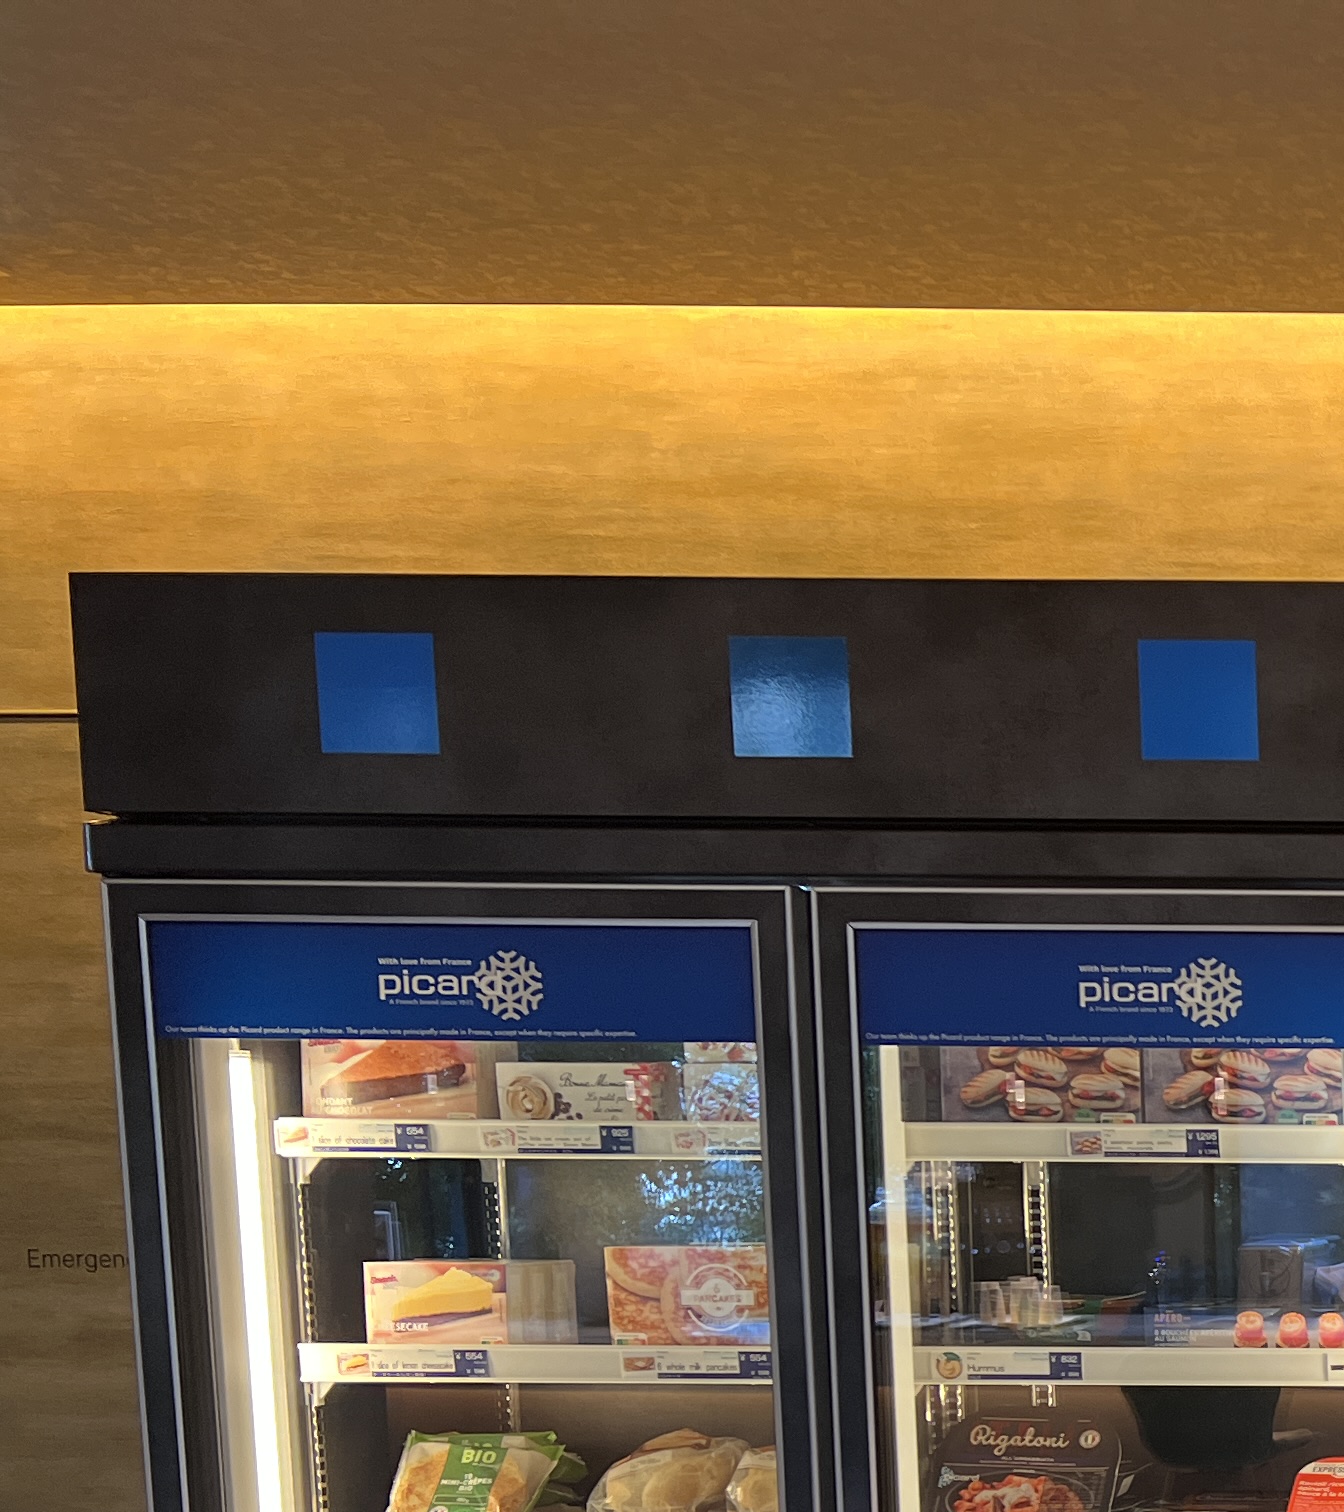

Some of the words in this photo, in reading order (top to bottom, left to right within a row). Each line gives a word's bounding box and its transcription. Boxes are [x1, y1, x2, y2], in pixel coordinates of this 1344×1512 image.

[379, 969, 501, 1000] picard
[1079, 977, 1201, 1007] picard
[378, 1137, 393, 1145] cake
[28, 1249, 129, 1273] Emergen
[706, 1363, 737, 1372] pancakes
[967, 1364, 1005, 1372] Hummus
[970, 1424, 1069, 1456] Rigatoni
[461, 1449, 497, 1463] BIO
